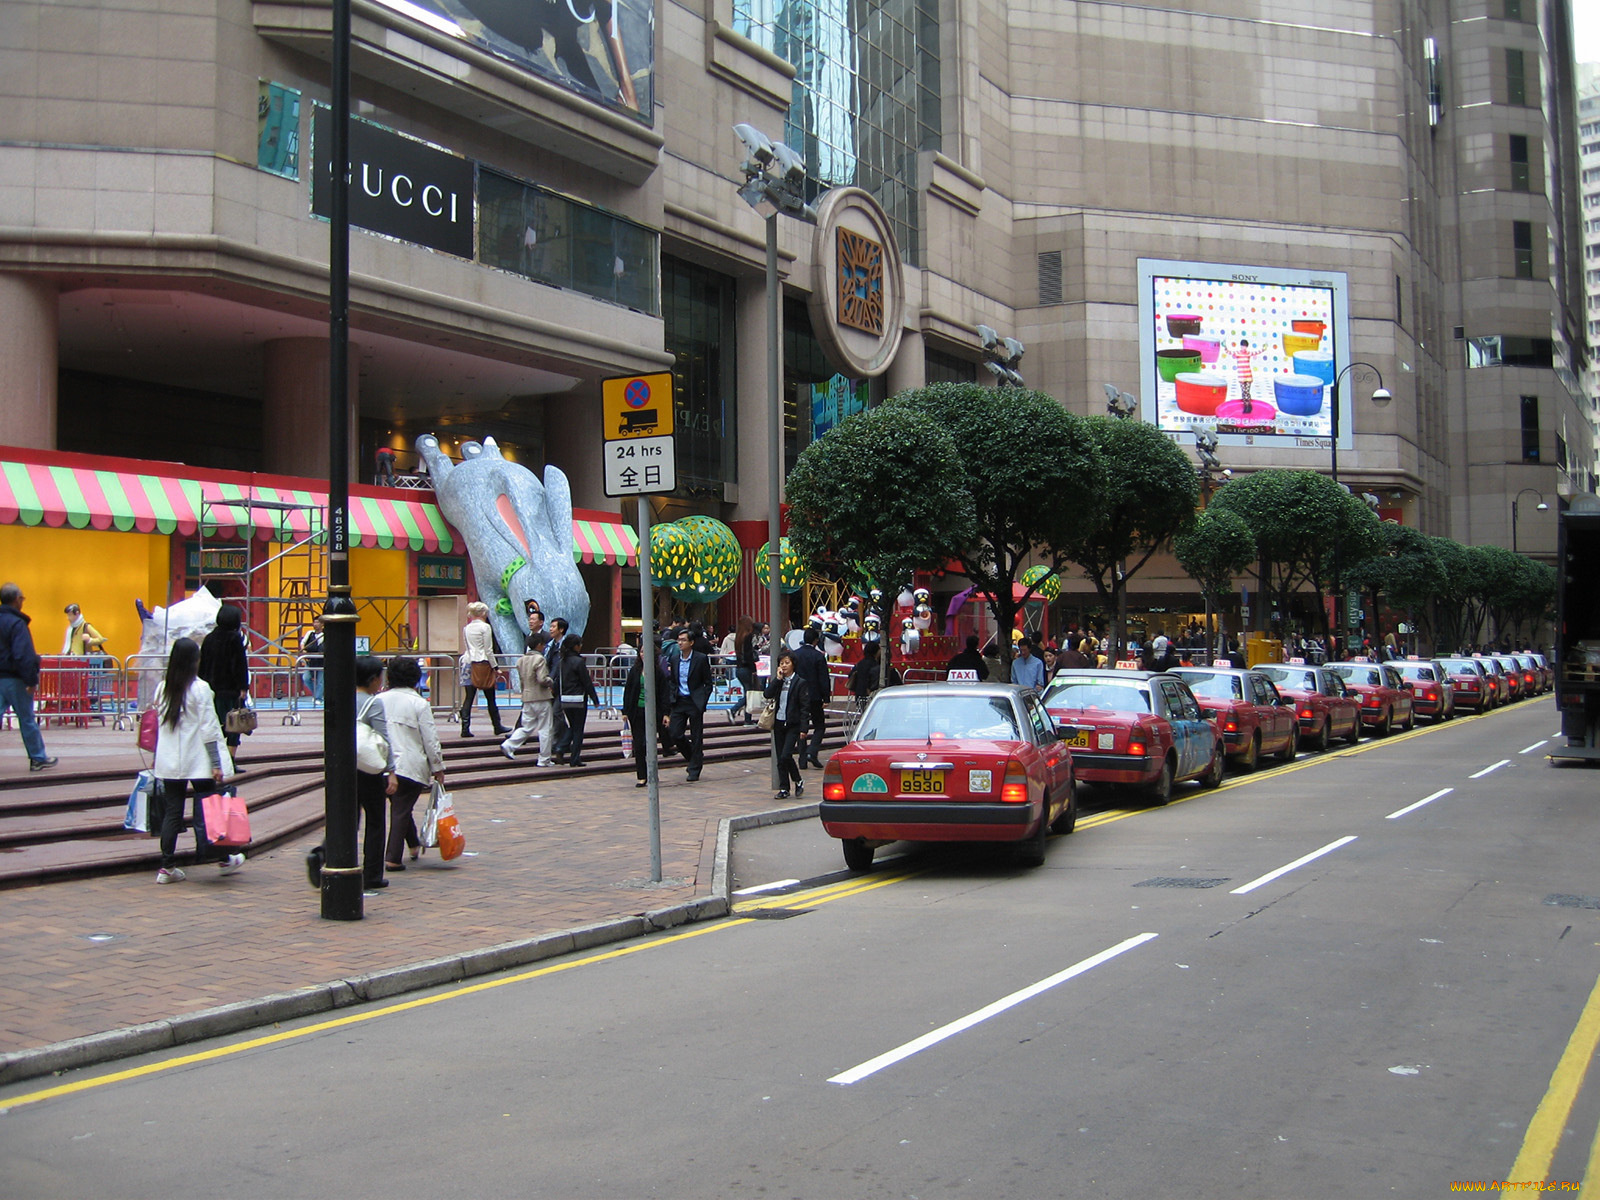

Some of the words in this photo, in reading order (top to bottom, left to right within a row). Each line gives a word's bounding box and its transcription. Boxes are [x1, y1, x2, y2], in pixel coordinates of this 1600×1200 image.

[1294, 437, 1315, 447] Times
[616, 446, 636, 459] 24
[641, 445, 662, 457] hrs
[619, 465, 661, 488] 全日
[334, 506, 344, 551] 48298
[221, 553, 247, 569] SHOP
[1117, 661, 1136, 669] TAXI
[951, 671, 975, 680] TAXI
[1063, 737, 1087, 746] 248
[912, 769, 932, 781] FU
[866, 779, 873, 788] 5
[902, 780, 943, 792] 9930
